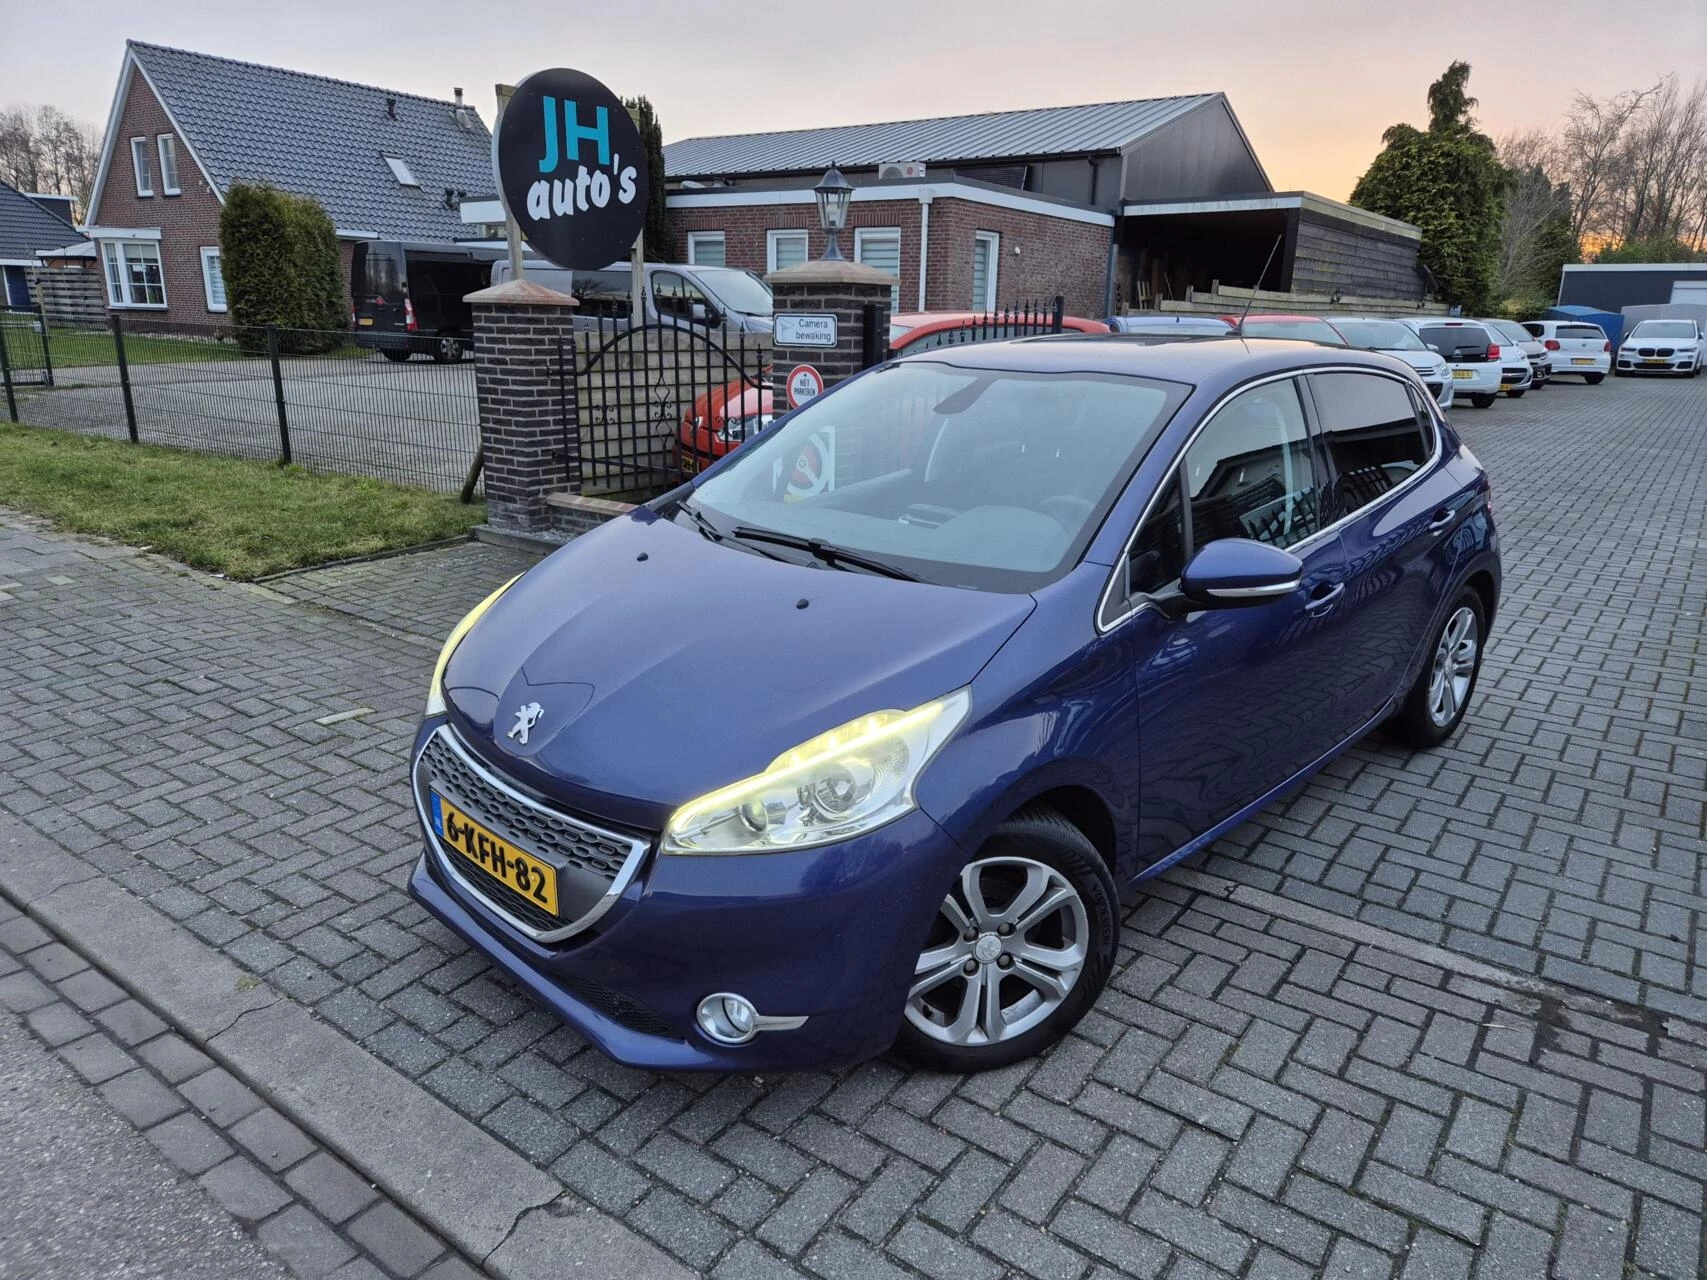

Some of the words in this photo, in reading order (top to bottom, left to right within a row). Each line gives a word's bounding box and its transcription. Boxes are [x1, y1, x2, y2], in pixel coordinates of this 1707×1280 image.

[538, 95, 610, 173] JH
[527, 153, 637, 221] auto's
[798, 318, 828, 329] Camera
[795, 331, 832, 342] bewaking
[799, 378, 810, 387] NIET
[793, 387, 816, 396] PARKEREN
[446, 811, 548, 904] 6-KFH-82
